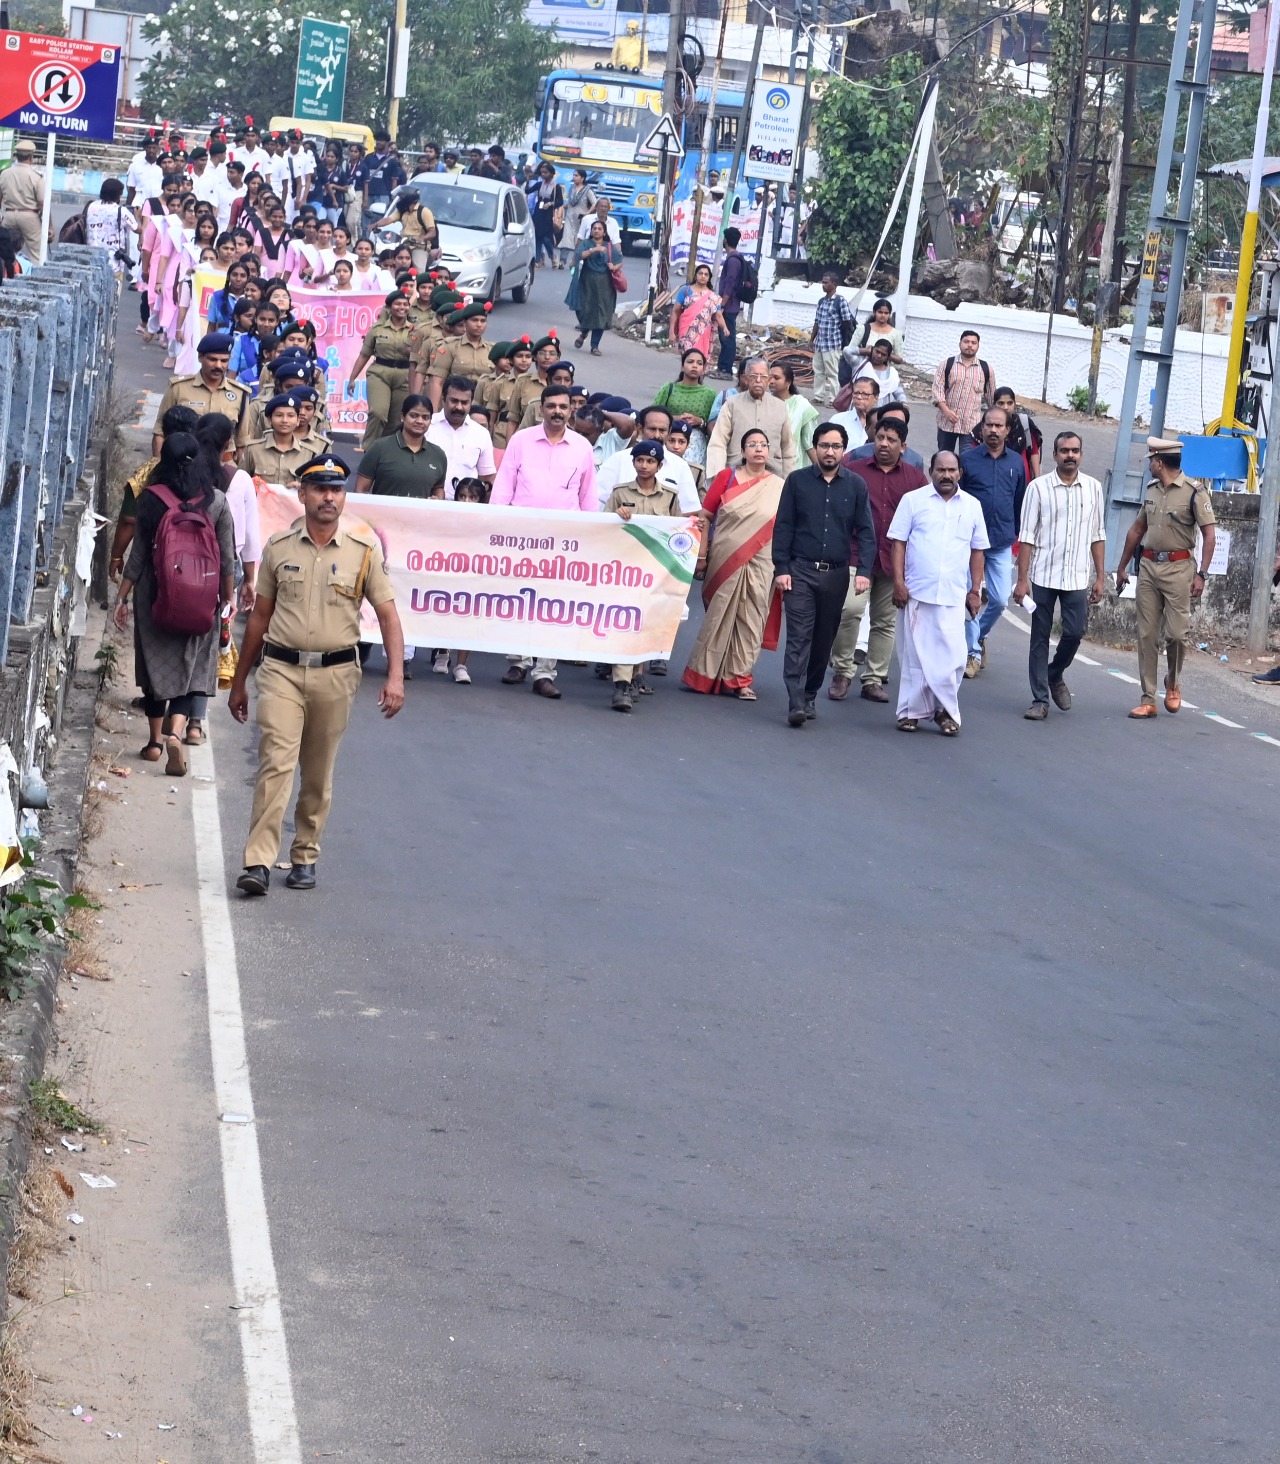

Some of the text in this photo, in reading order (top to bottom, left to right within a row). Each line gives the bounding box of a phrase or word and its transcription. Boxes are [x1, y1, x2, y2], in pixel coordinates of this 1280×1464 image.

[29, 37, 94, 51] EAST POLICE STATION
[49, 46, 73, 55] KOLLAM
[20, 111, 88, 132] NO U-TURN
[754, 121, 795, 133] Petroleum
[762, 113, 789, 124] Bharat
[488, 533, 579, 553] ജനുവരി 30
[406, 548, 655, 589] രക്തസാക്ഷിത്വദിനം
[410, 586, 643, 638] ശാന്തിയാത്ര
